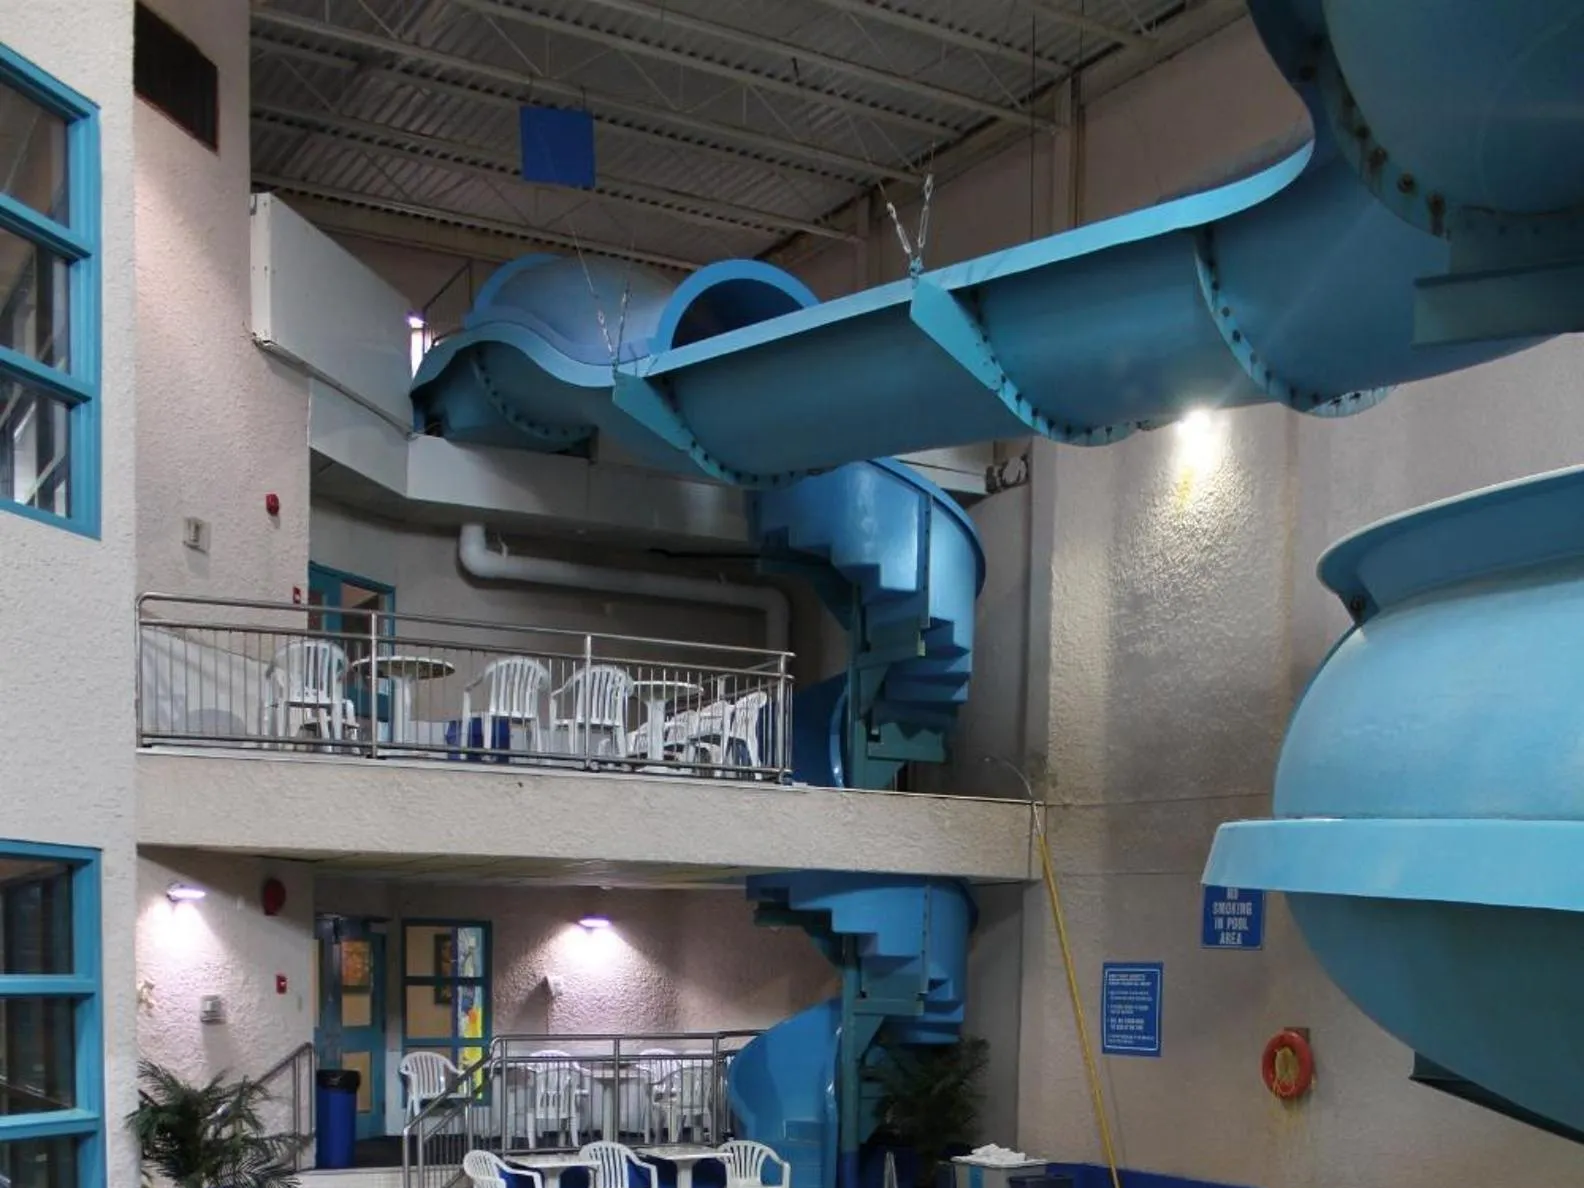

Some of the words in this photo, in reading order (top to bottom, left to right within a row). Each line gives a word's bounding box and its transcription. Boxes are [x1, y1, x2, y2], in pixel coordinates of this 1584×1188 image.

[1212, 901, 1253, 916] SMOKING
[1214, 917, 1224, 930] IN
[1227, 917, 1249, 930] POOL
[1219, 931, 1243, 945] AREA
